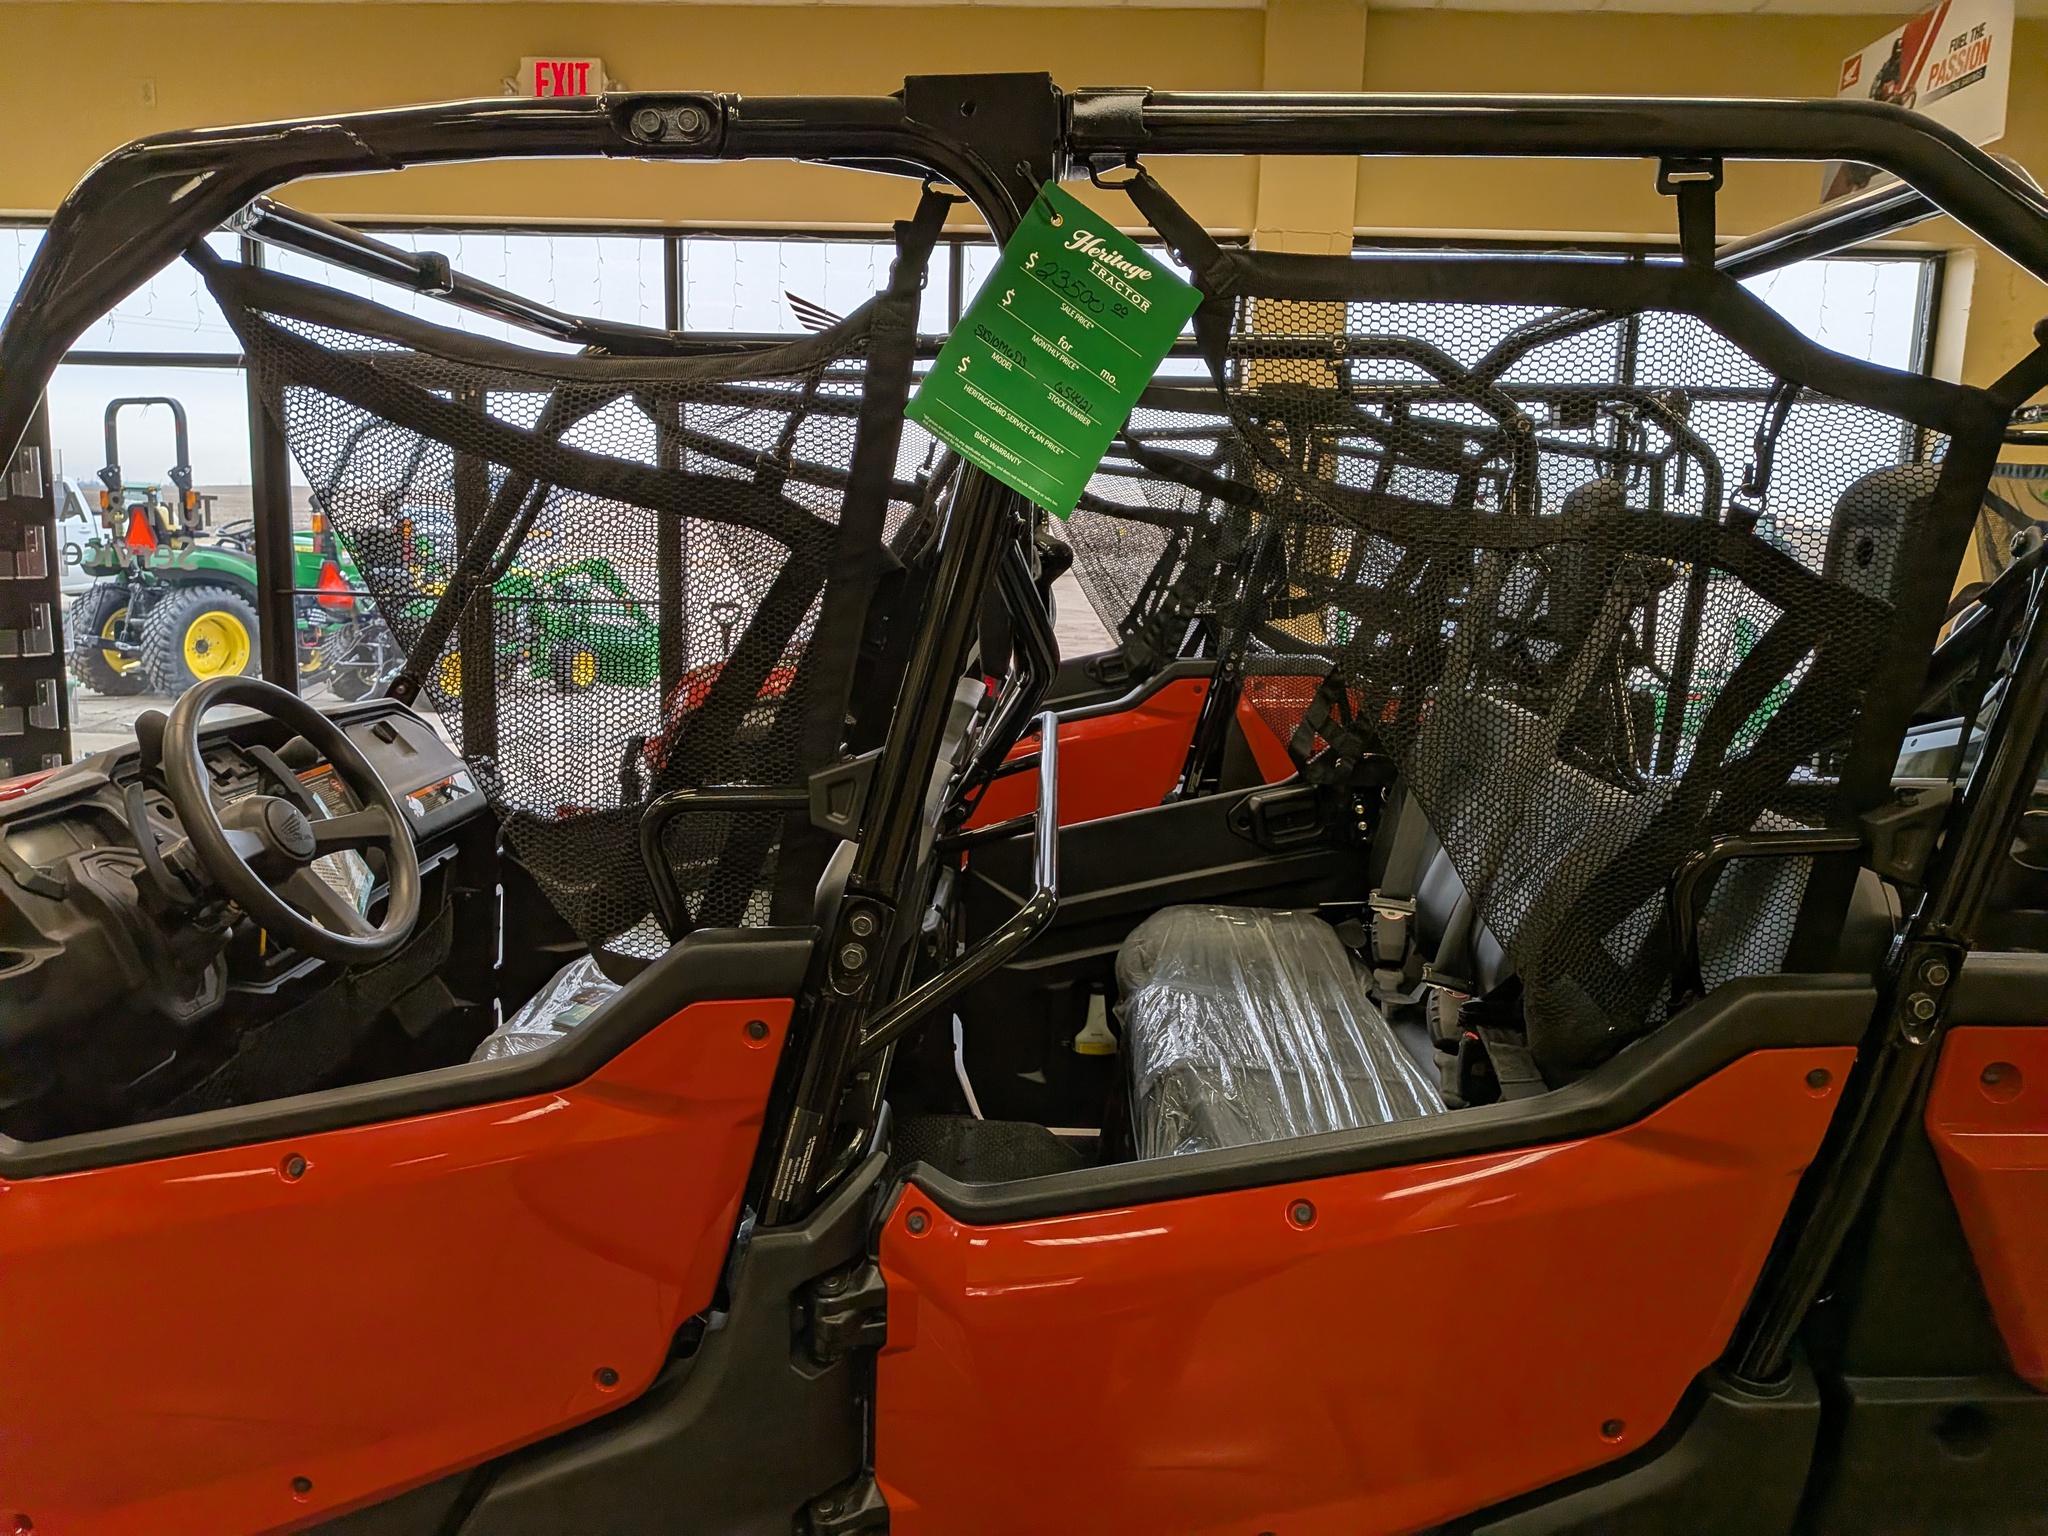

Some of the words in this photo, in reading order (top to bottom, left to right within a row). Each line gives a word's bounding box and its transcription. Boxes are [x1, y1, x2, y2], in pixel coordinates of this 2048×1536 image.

[1949, 32, 1967, 54] FUEL
[1970, 22, 1986, 42] THE
[535, 62, 590, 97] EXIT
[1926, 34, 1993, 92] PASSION
[1025, 251, 1038, 269] $
[1064, 230, 1152, 280] Heritage
[1090, 261, 1150, 311] TRACTOR
[1060, 302, 1076, 318] SALE
[1002, 288, 1015, 306] $
[1057, 335, 1073, 352] for
[1100, 369, 1116, 386] mo.
[1031, 335, 1061, 358] MONTHLY
[957, 356, 971, 373] $
[991, 352, 1012, 372] MODEL
[963, 384, 1007, 418] HERITAGEGARD
[1005, 413, 1029, 434] SERVICE
[1028, 430, 1045, 444] PLAN
[1047, 392, 1067, 410] STOCK
[1065, 404, 1091, 427] NUMBER
[973, 431, 989, 446] BASE
[989, 441, 1022, 466] WARRANTY
